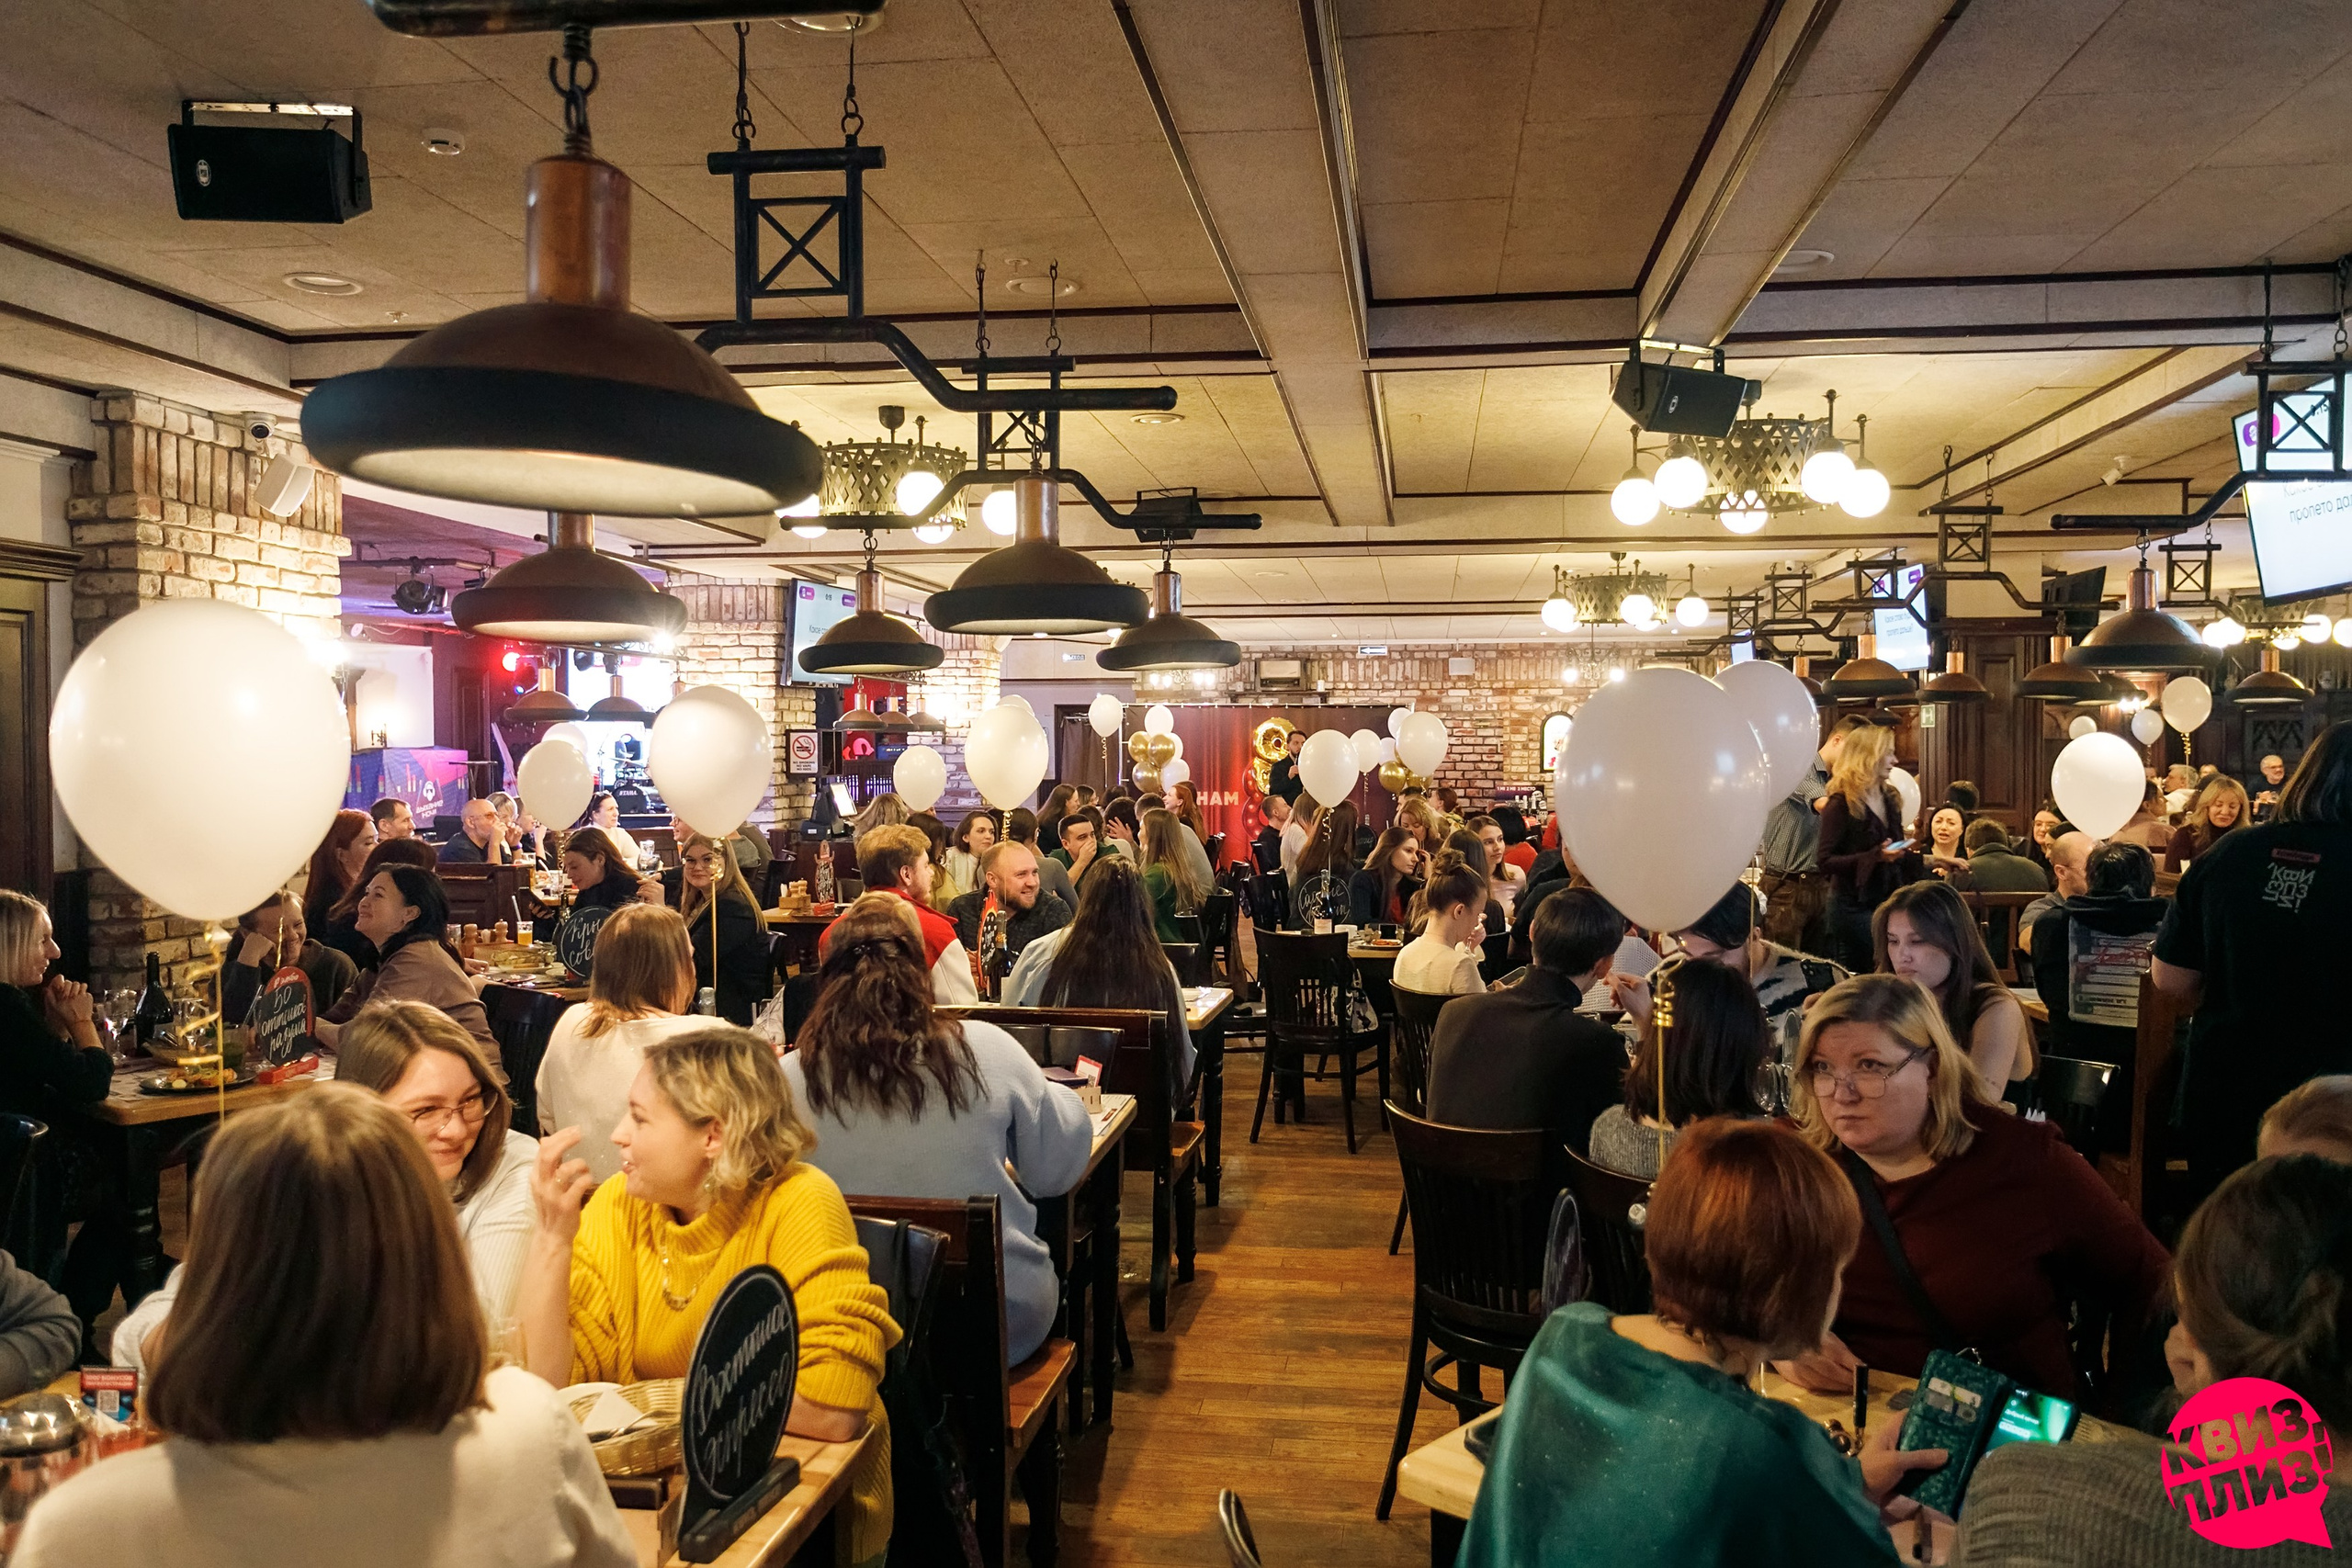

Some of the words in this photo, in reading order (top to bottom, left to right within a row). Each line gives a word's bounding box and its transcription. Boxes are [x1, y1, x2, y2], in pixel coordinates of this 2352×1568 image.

[2290, 501, 2334, 525] пропето
[2336, 494, 2352, 513] да
[274, 986, 292, 1014] 50
